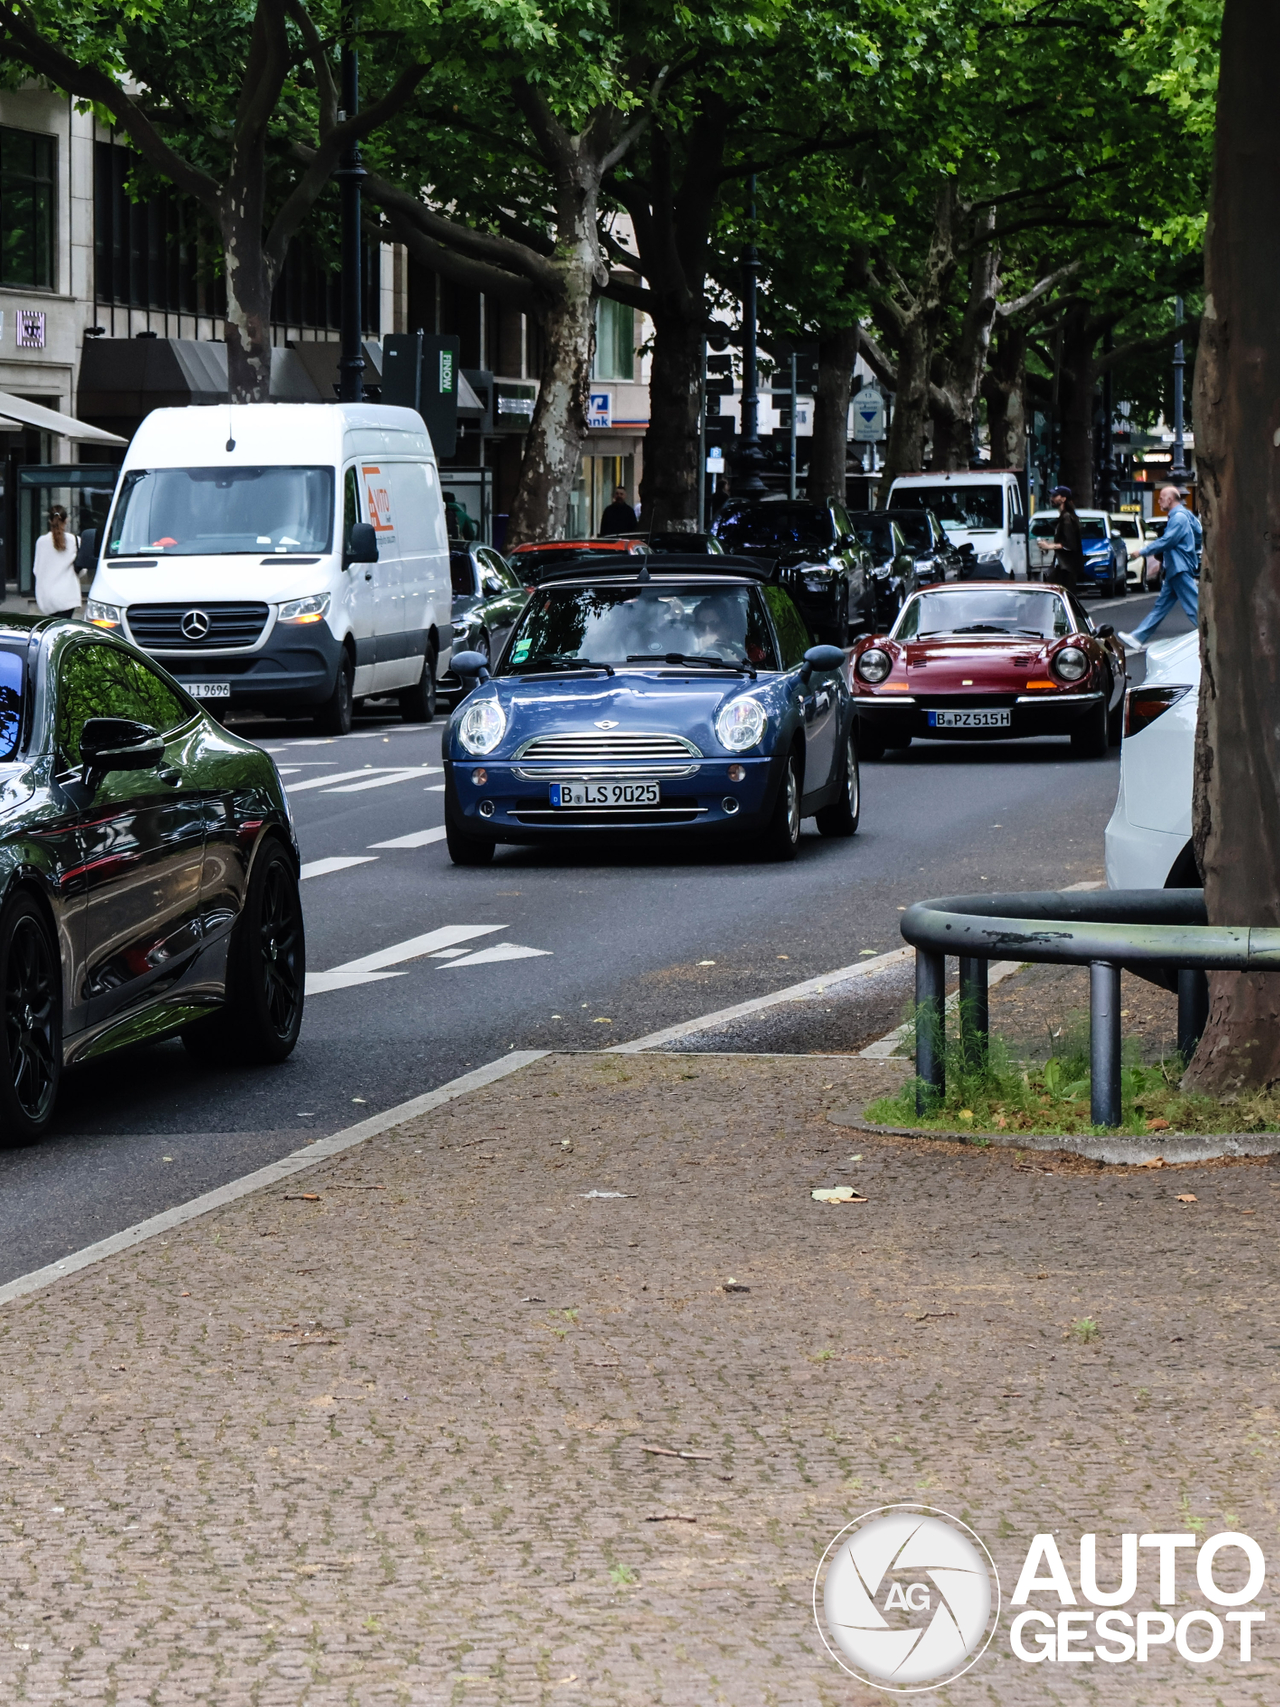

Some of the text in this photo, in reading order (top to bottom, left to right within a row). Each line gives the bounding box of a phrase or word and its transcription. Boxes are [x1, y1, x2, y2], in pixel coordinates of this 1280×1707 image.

[443, 354, 452, 390] FINOW
[189, 685, 229, 696] LI 9696
[937, 713, 1010, 726] B PZ 515H
[561, 787, 573, 804] B
[584, 787, 608, 804] LS
[612, 785, 657, 803] 9025
